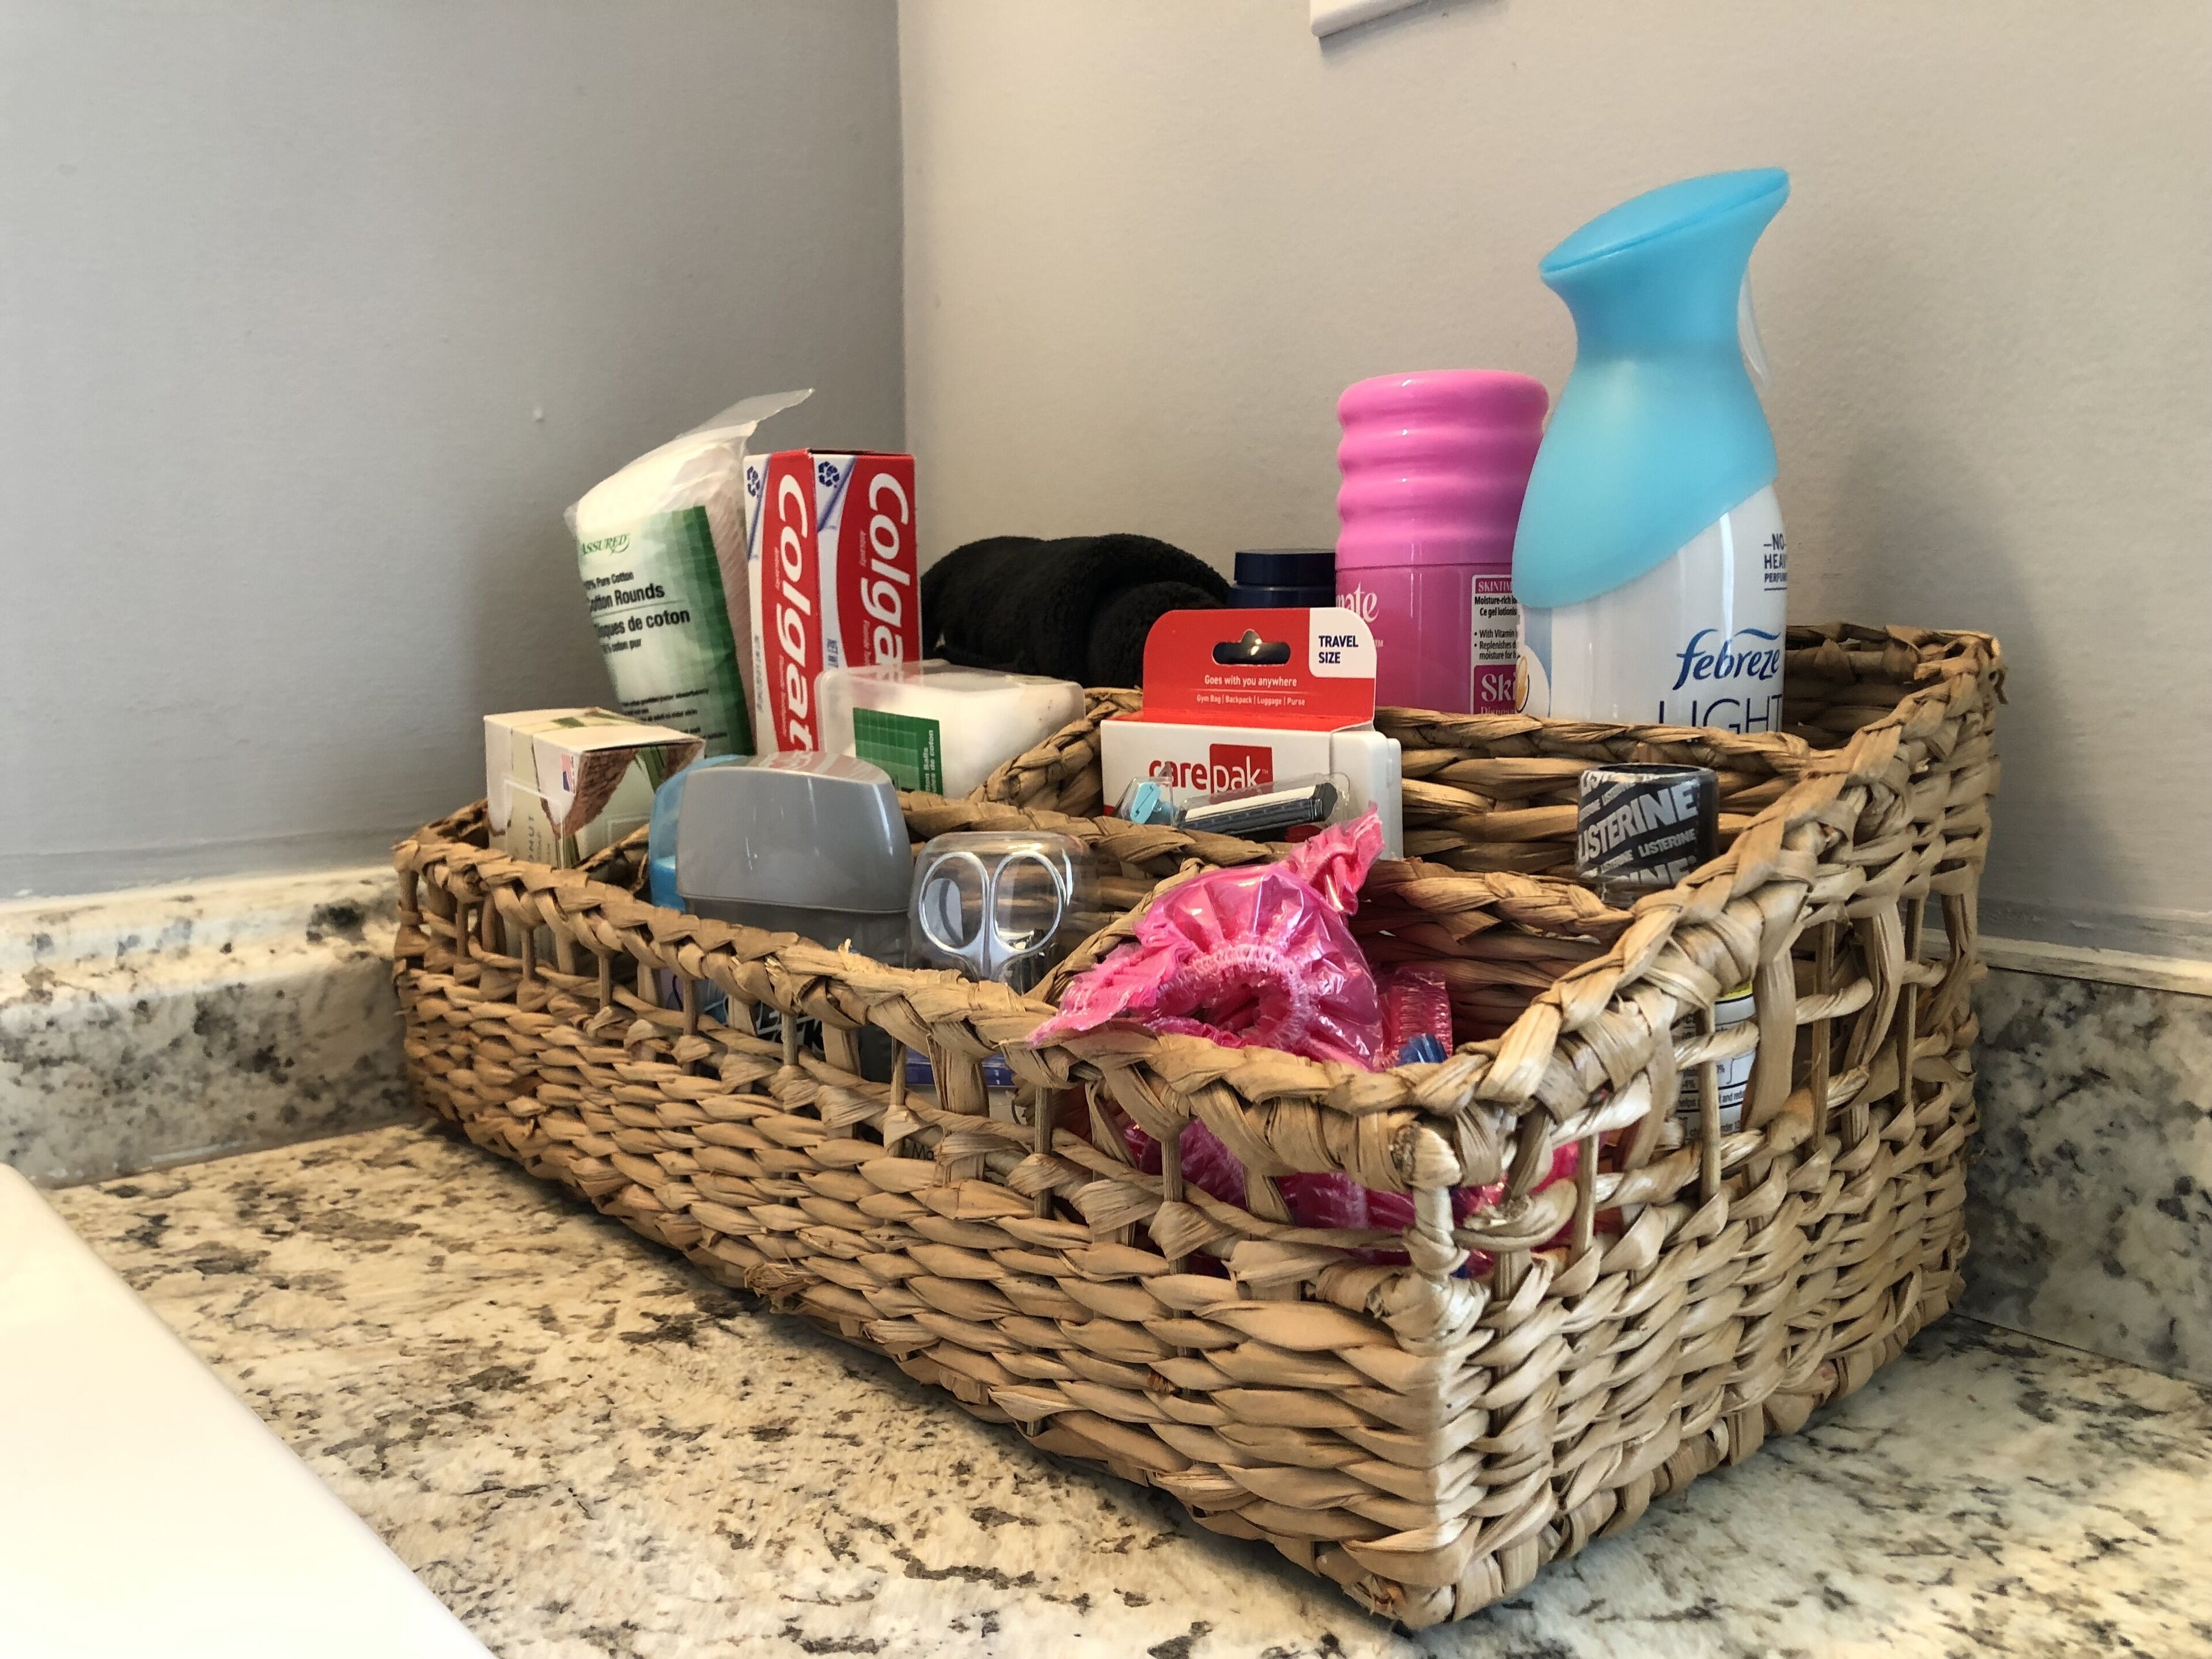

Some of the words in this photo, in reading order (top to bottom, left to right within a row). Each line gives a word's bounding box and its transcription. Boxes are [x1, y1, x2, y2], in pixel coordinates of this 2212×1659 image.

[614, 583, 665, 605] Rounds
[1475, 596, 1511, 605] Moisture-rich
[777, 474, 813, 751] Colgat
[1480, 608, 1487, 616] Ce
[1488, 607, 1497, 619] gel
[628, 615, 643, 632] de
[646, 609, 691, 628] coton
[1479, 629, 1494, 638] With
[1494, 628, 1514, 638] Vitamin
[1318, 635, 1359, 647] TRAVEL
[1479, 641, 1512, 652] Replenishes
[1318, 652, 1341, 664] SIZE
[1479, 652, 1504, 660] moisture
[1505, 650, 1513, 659] for
[1672, 628, 1781, 691] febreze
[1205, 674, 1222, 685] Goes
[1224, 675, 1240, 685] with
[1242, 677, 1256, 687] you
[1257, 676, 1297, 688] anywhere
[1196, 694, 1209, 703] Gym
[1210, 695, 1221, 704] Bag
[1225, 695, 1252, 705] Backpack
[1256, 696, 1282, 707] Luggage
[1286, 697, 1306, 706] Purse
[930, 759, 935, 771] de
[1577, 778, 1700, 865] LISTERINE
[1638, 828, 1696, 858] LISTERINE
